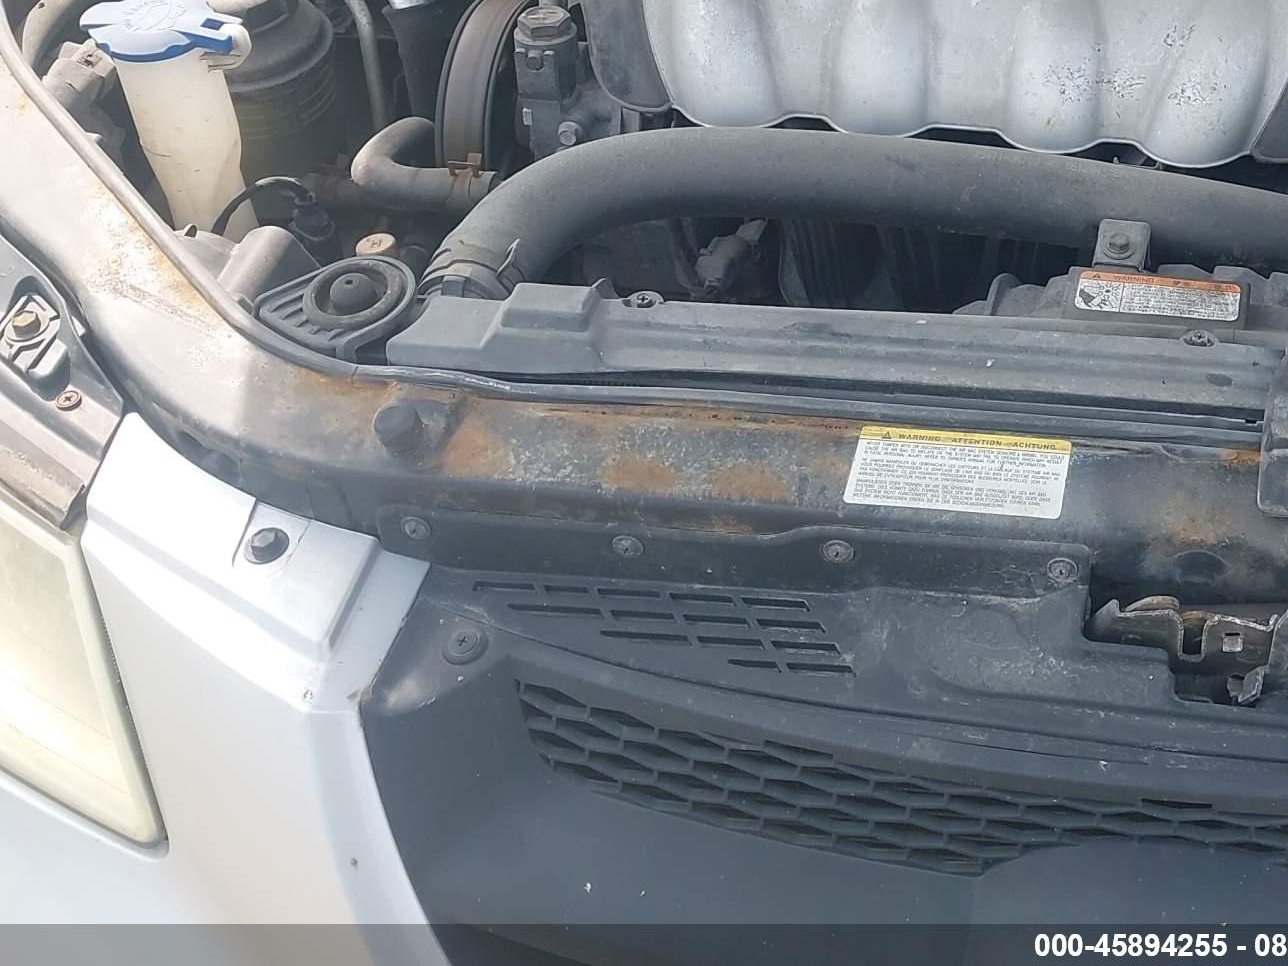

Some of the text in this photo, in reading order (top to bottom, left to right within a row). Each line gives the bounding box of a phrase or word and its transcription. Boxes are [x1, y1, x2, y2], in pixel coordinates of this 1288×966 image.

[1112, 274, 1156, 284] WARNING
[898, 433, 1056, 450] WARNING ATTENTION ACHTUNG
